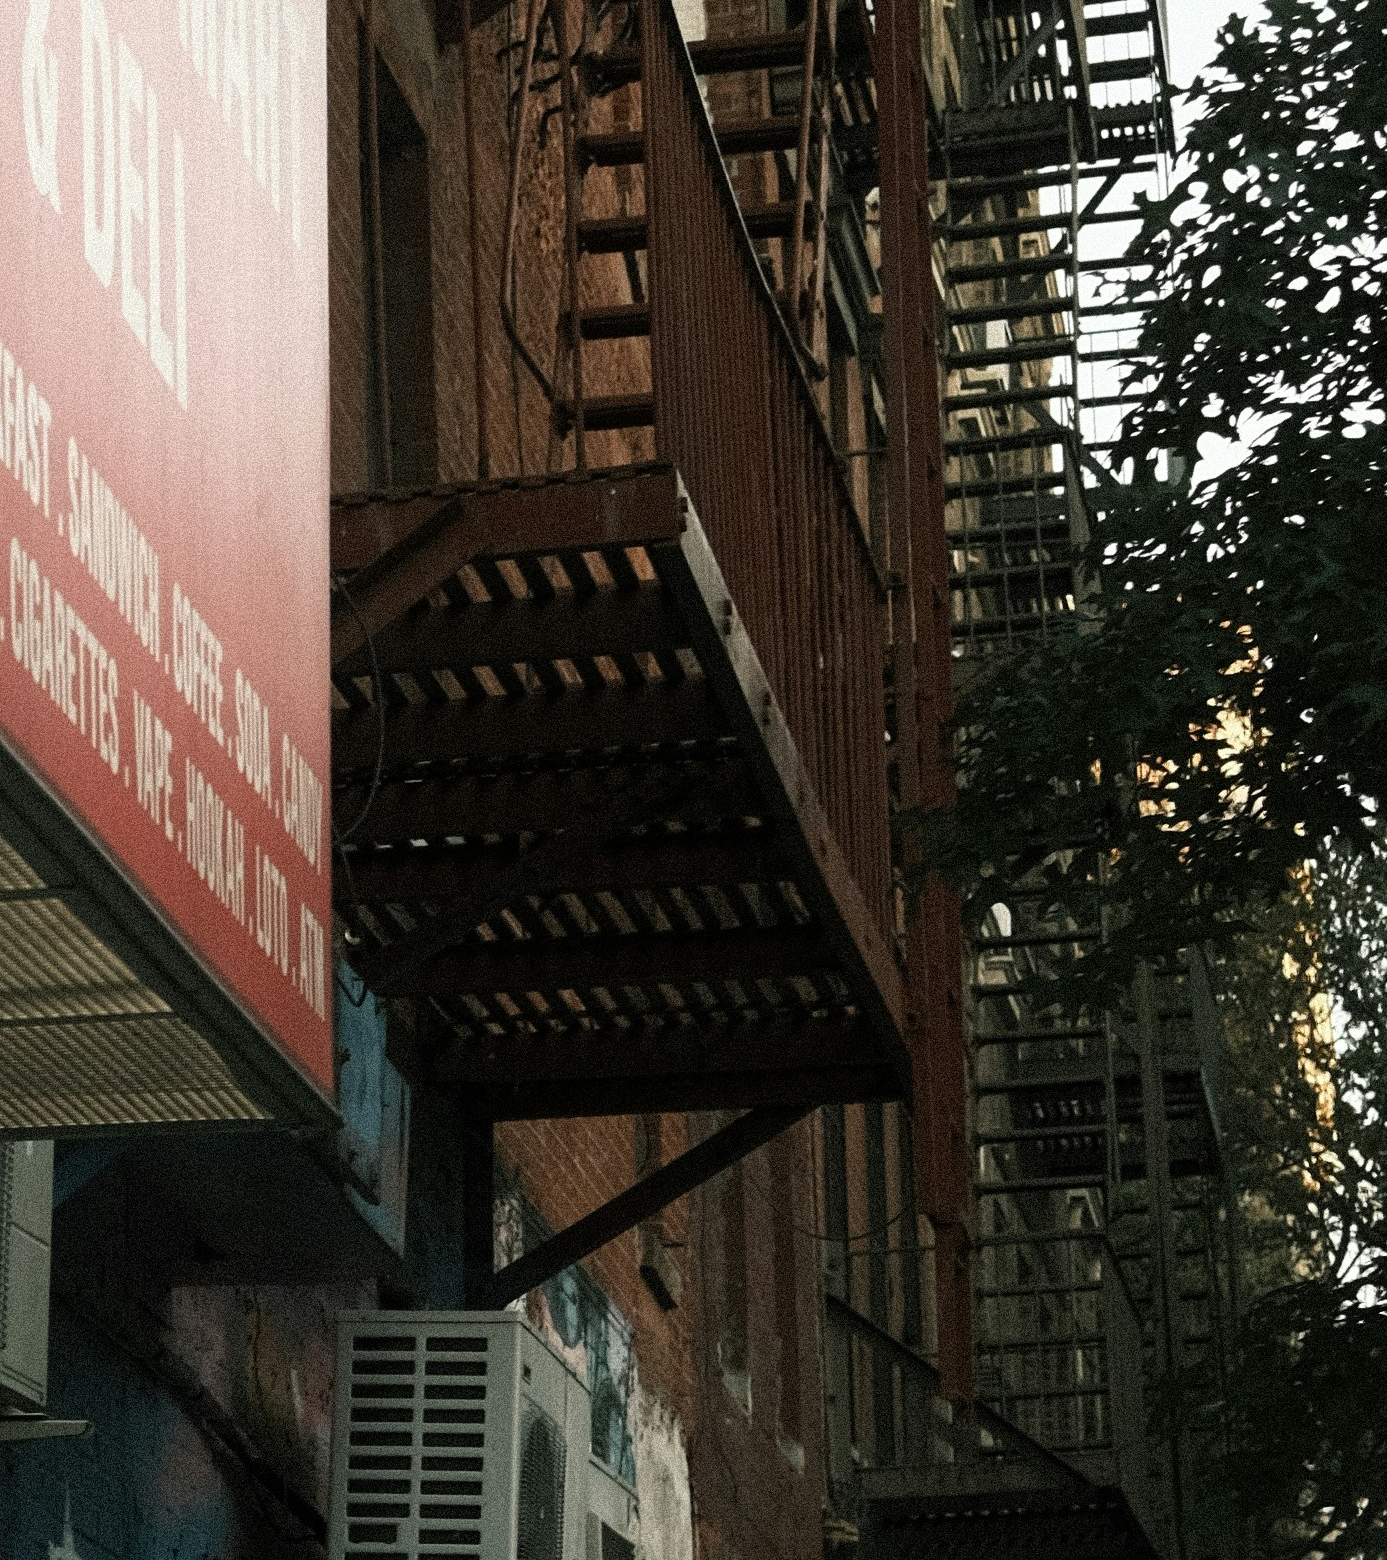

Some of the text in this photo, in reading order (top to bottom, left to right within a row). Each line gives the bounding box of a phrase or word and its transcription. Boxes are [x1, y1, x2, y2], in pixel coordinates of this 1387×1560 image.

[9, 537, 121, 775] CIGARETTES
[68, 436, 161, 662] SANDWICH
[172, 581, 224, 746] COFFEE
